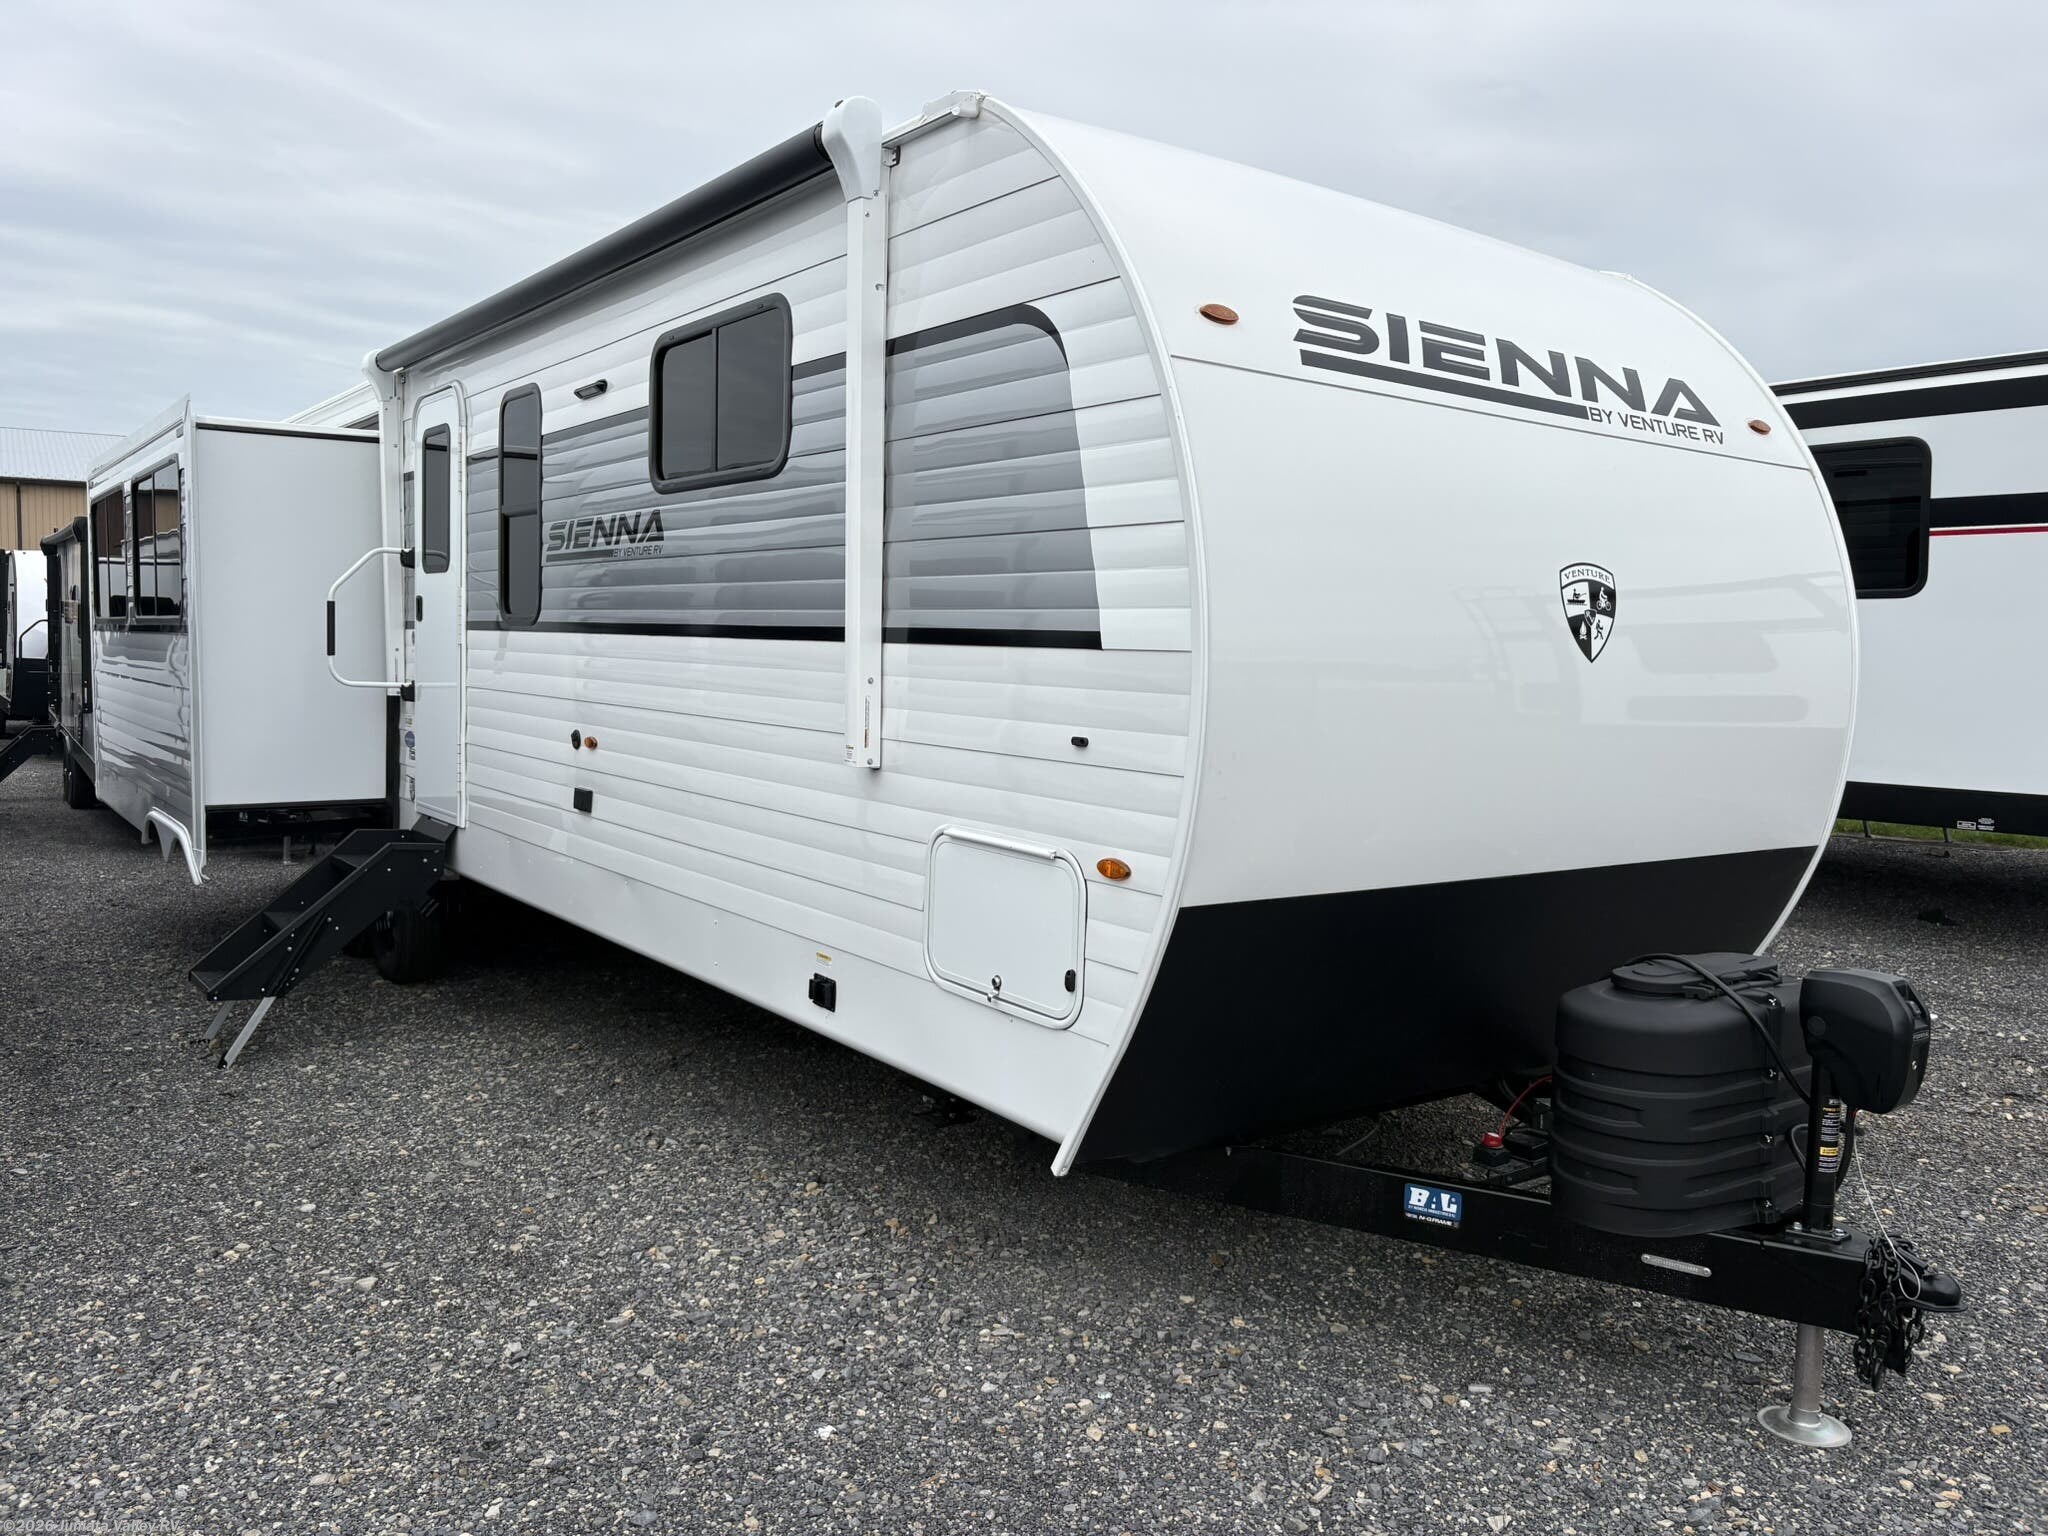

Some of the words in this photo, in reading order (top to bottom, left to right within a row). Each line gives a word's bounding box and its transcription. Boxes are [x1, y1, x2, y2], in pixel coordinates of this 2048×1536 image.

[1292, 294, 1722, 427] SIENNA
[1588, 406, 1613, 425] BY
[1617, 411, 1701, 441] VENTURE
[1701, 428, 1724, 445] RV
[546, 509, 665, 552] SIENNA
[622, 545, 653, 557] VENTURE
[653, 544, 664, 555] RV
[1563, 568, 1612, 585] VENTURE
